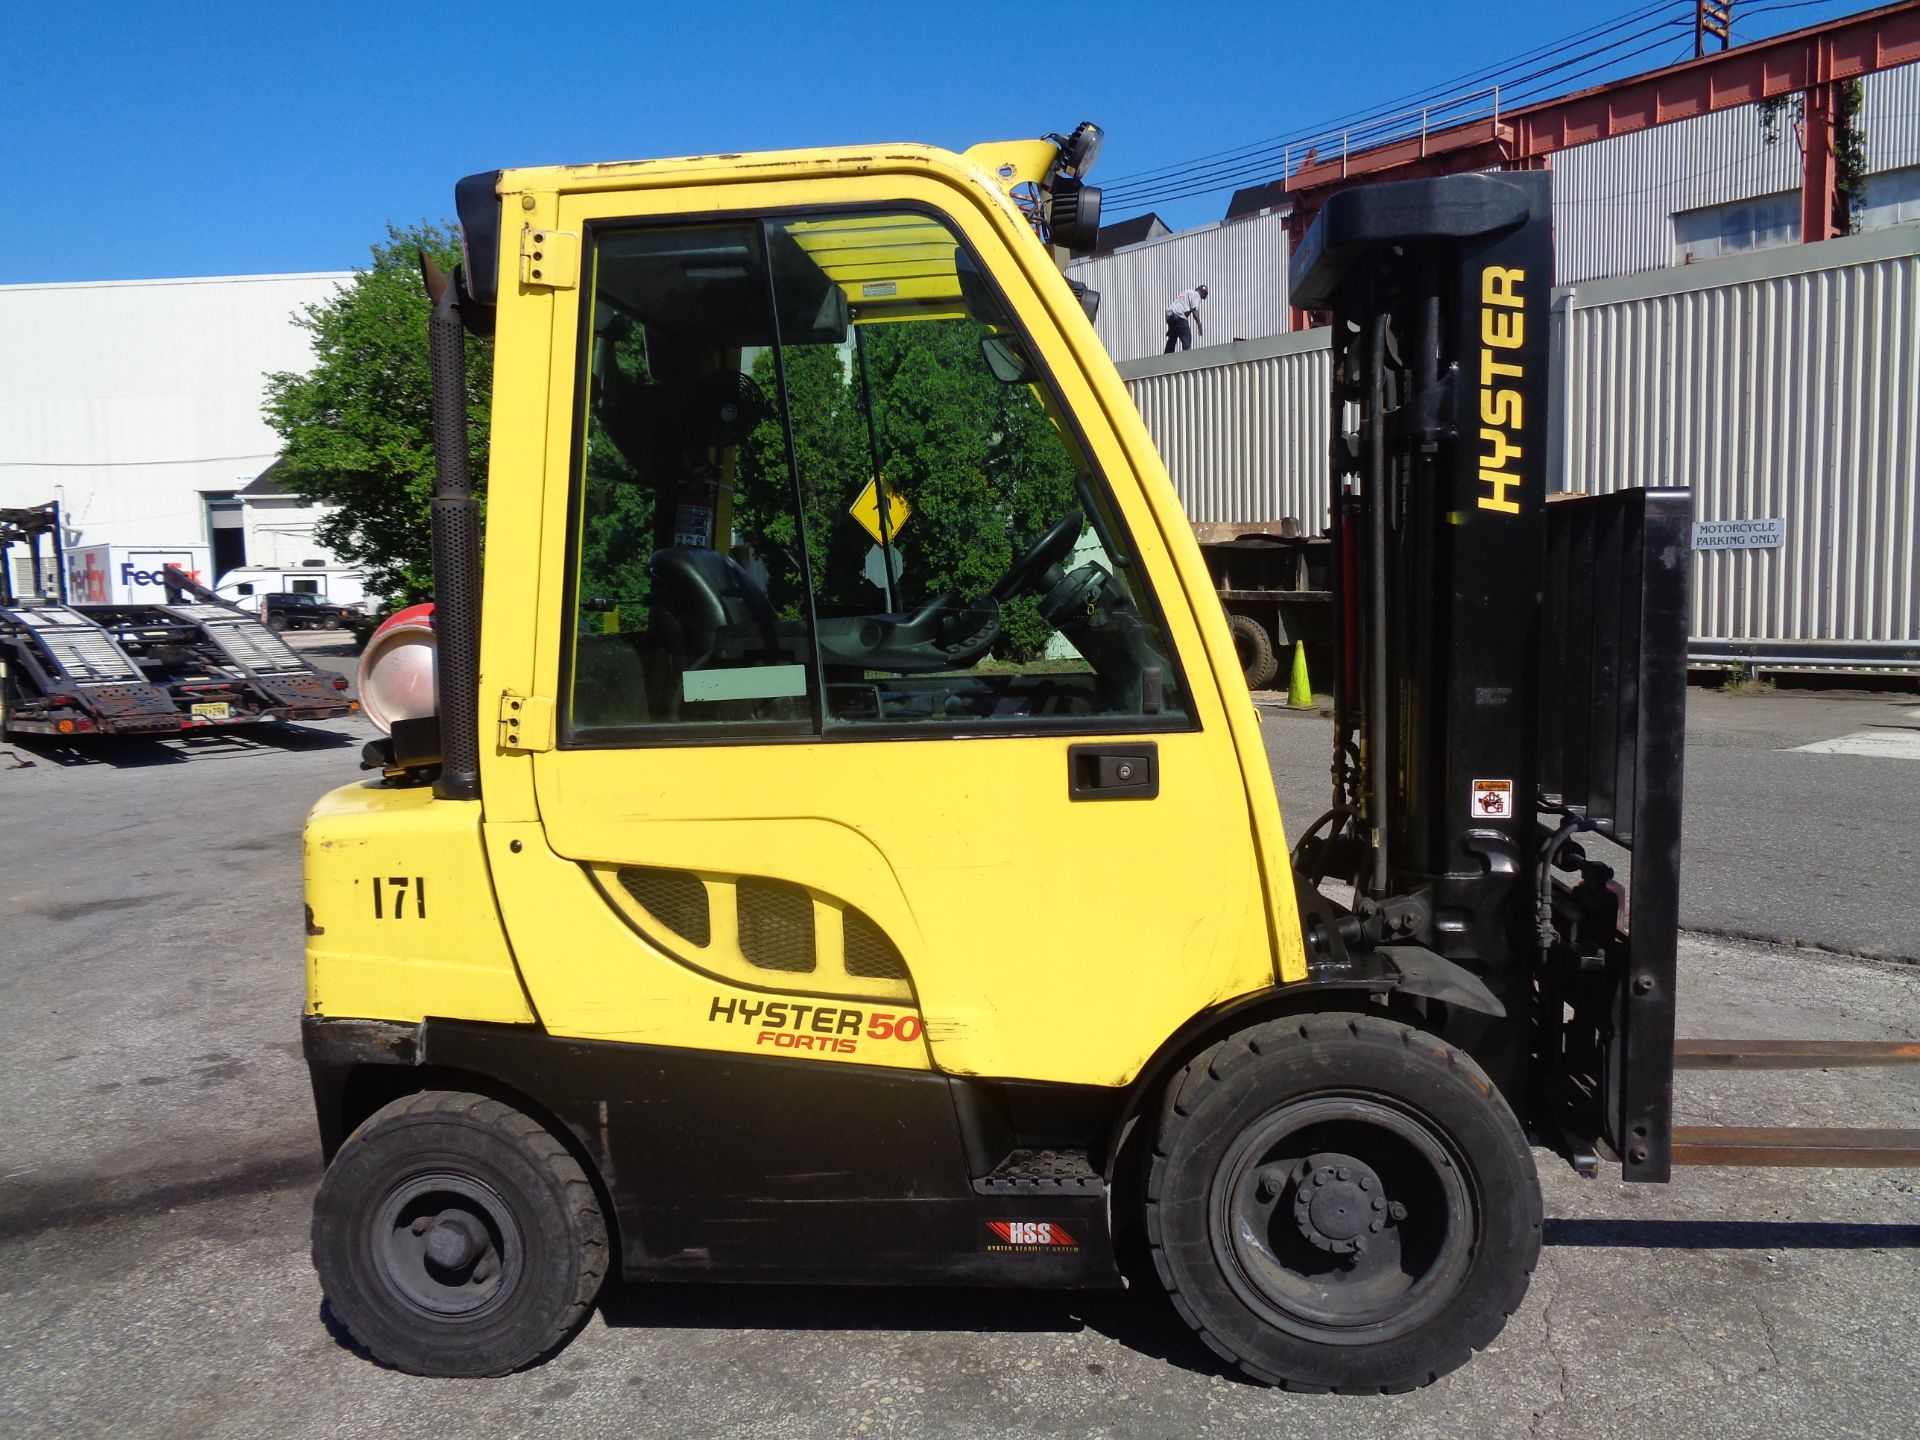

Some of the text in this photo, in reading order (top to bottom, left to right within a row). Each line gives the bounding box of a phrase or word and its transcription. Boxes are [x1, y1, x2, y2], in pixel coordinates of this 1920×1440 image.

[1478, 265, 1525, 514] HYSTER
[1700, 522, 1776, 534] MOTORCYCLE
[1696, 534, 1779, 546] PARKING ONLY
[373, 877, 426, 919] 171
[709, 996, 922, 1042] HYSTER 50
[757, 1031, 857, 1053] FORTIS
[1010, 1222, 1051, 1243] HSS
